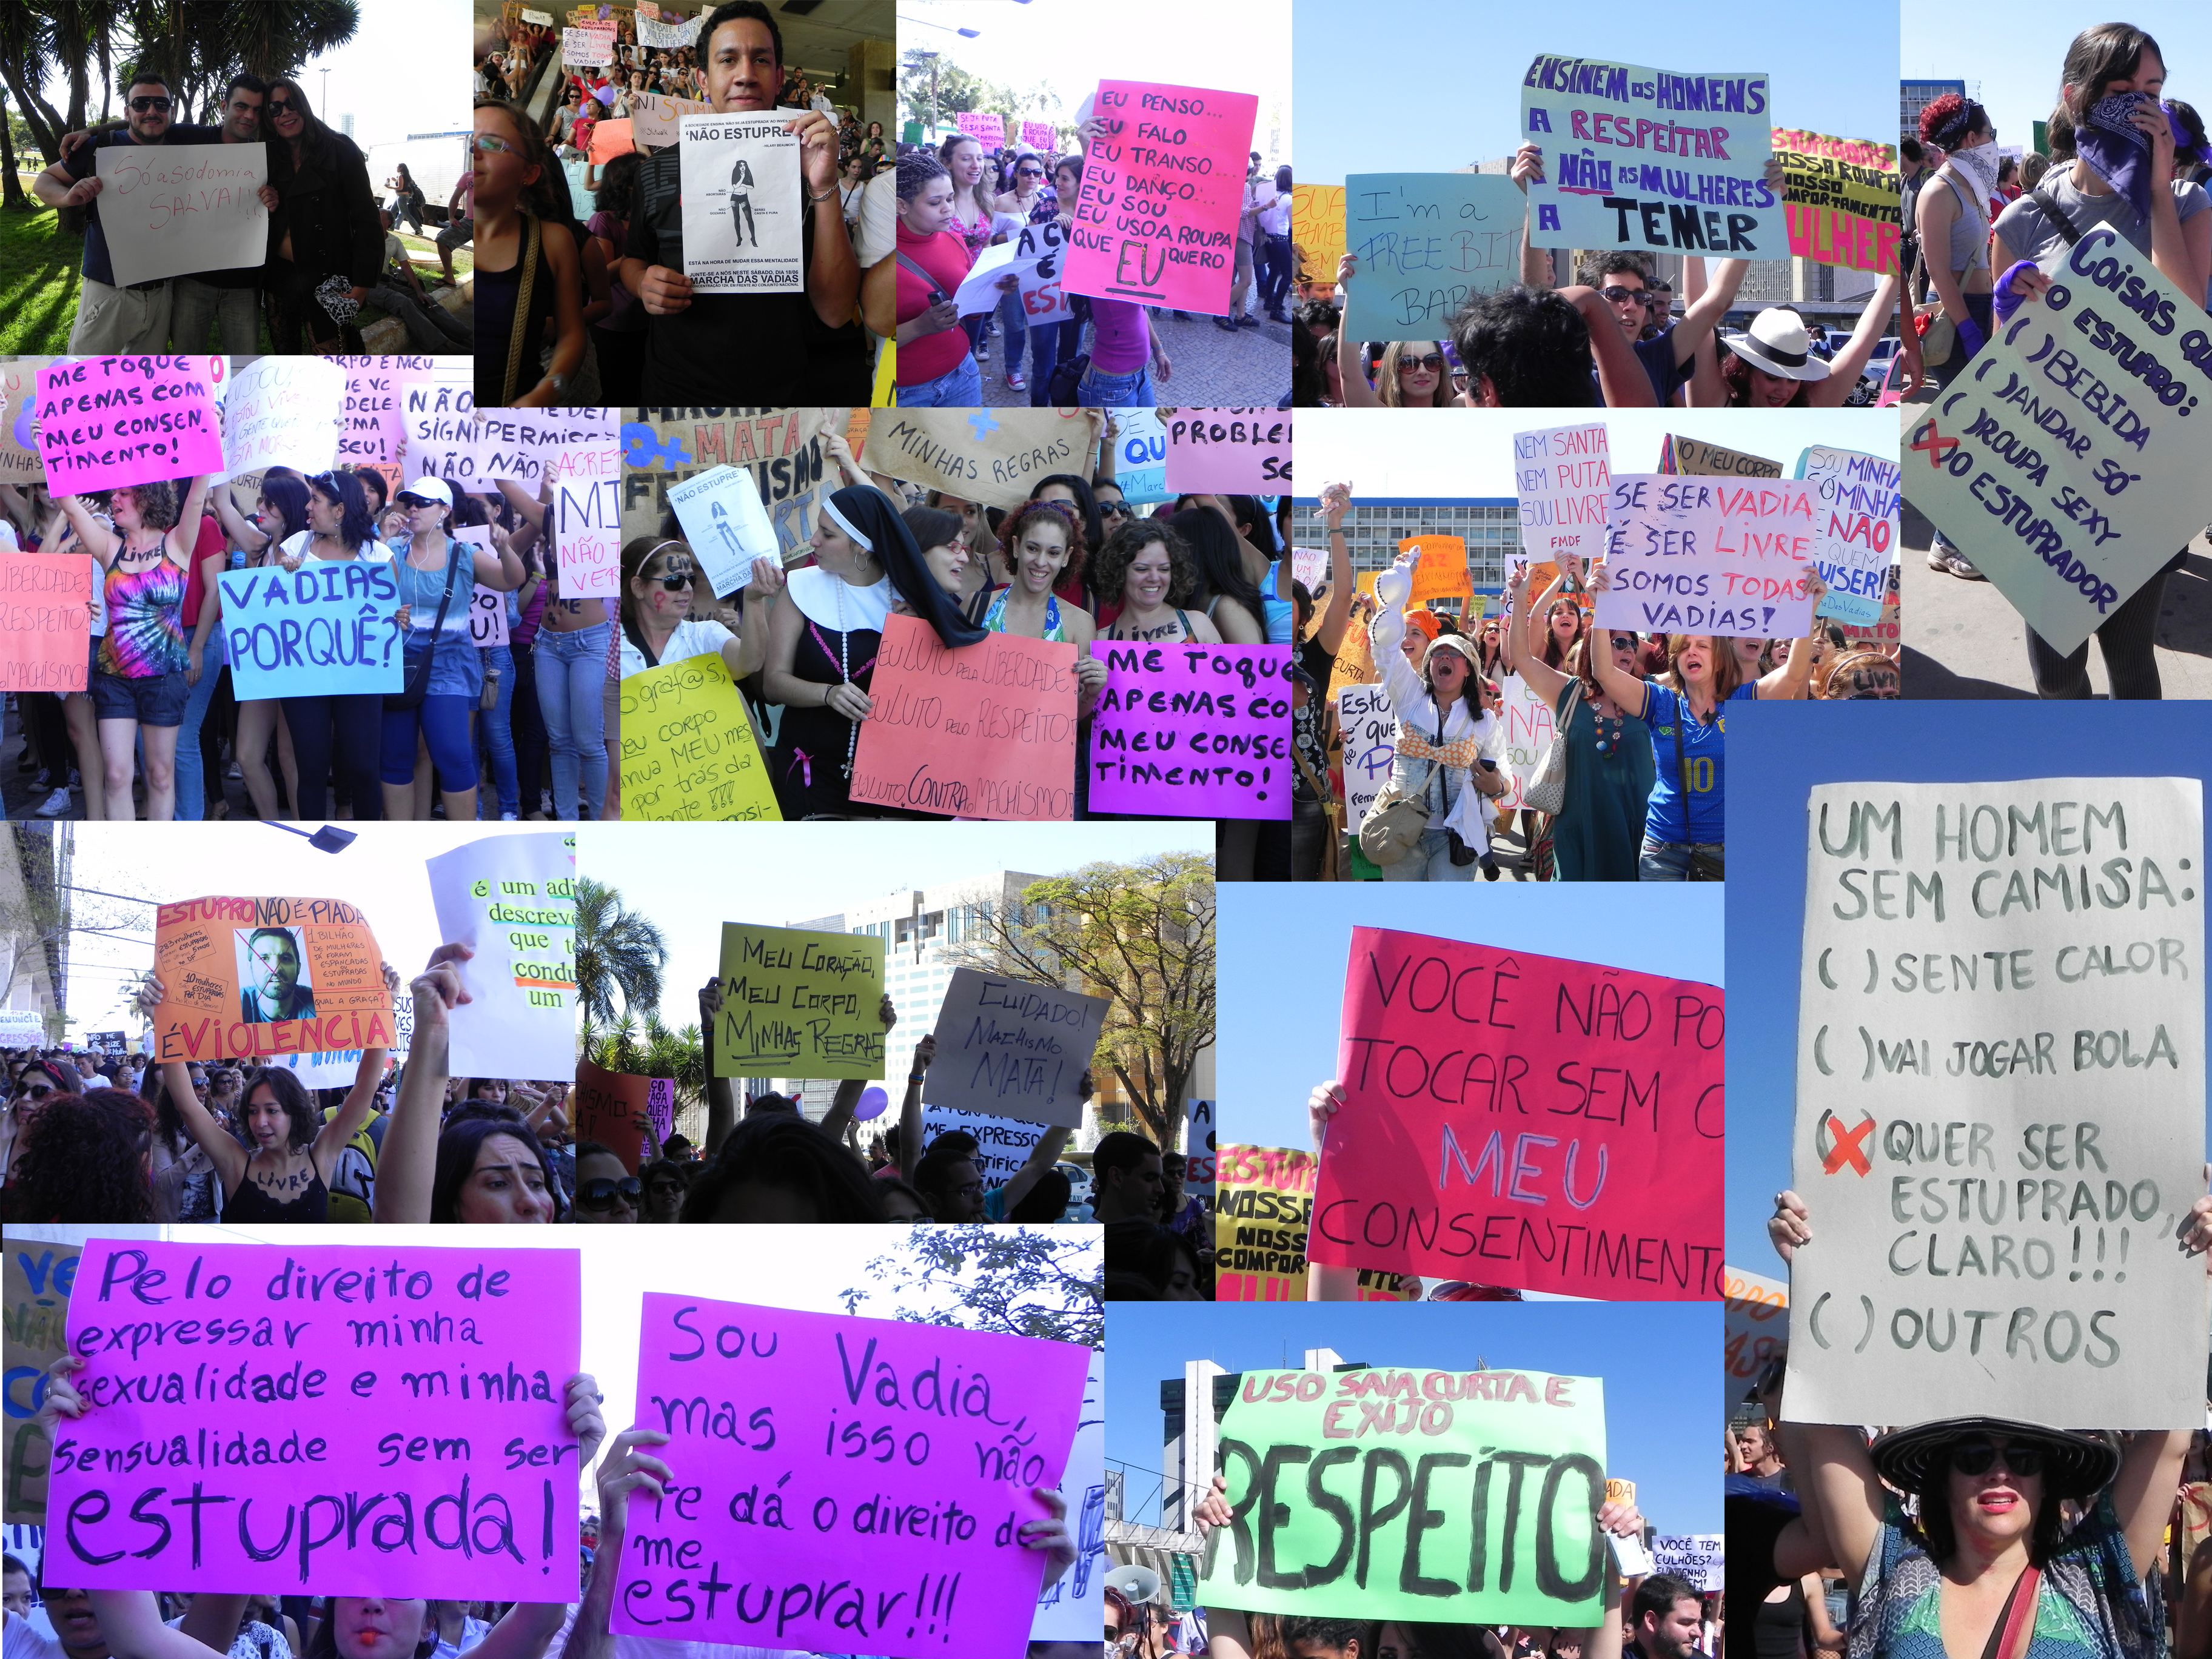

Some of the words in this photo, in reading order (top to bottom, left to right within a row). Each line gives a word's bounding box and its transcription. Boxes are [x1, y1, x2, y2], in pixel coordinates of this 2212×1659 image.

[589, 32, 611, 41] VADIA
[1102, 91, 1128, 108] EU
[1524, 56, 1629, 102] ENSINEM
[1657, 74, 1766, 115] HOMENS
[640, 127, 668, 136] #Slutwalk
[686, 127, 720, 141] 'NÃO
[1091, 142, 1121, 162] EU
[1529, 108, 1552, 132] A
[1570, 109, 1731, 160] RESPEITAR
[1086, 166, 1115, 184] EU
[1558, 149, 1613, 190] NÃO
[1640, 164, 1774, 208] MULHERES
[1077, 204, 1107, 224] EU
[1179, 226, 1232, 250] ROUPA
[1603, 196, 1758, 252] TEMER
[1073, 229, 1113, 253] QUE
[1169, 247, 1225, 269] QUERO
[1117, 240, 1166, 286] EU
[1358, 232, 1443, 275] FREE
[691, 276, 734, 284] MARCHA
[2070, 228, 2177, 337] COISAS
[49, 366, 87, 390] ME
[43, 390, 143, 419] APENAS
[152, 380, 205, 401] COM
[46, 424, 103, 449] MEU
[48, 437, 179, 474] TIMENTO!
[695, 415, 801, 464] MATA
[888, 420, 979, 480] MINHAS
[993, 438, 1071, 484] REGRAS
[1515, 435, 1547, 460] NEM
[1553, 428, 1607, 456] SANTA
[1558, 460, 1611, 489] PUTA
[1810, 448, 1843, 472] SOU
[1521, 503, 1553, 528] SOU
[1664, 483, 1711, 511] SER
[1717, 484, 1812, 521] VADIA
[2051, 485, 2122, 546] SEXY
[1550, 535, 1581, 548] FMDF
[1715, 526, 1808, 560] LIVRE
[1828, 511, 1890, 553] NÃO
[1969, 472, 2119, 614] ESTUPRADOR
[1828, 543, 1879, 572] QUEM
[221, 560, 397, 611] VADIAS
[1612, 568, 1709, 596] SOMOS
[1721, 572, 1808, 603] TODAS
[230, 600, 399, 672] PORQUÊ?
[1643, 600, 1777, 633] VADIAS!
[956, 664, 979, 682] PELA
[1108, 648, 1164, 673] ME
[1102, 689, 1237, 718] APENAS
[945, 719, 970, 736] PELO
[1095, 756, 1270, 800] TIMENTO!
[1934, 800, 2128, 865] HOMEM
[502, 881, 535, 896] um
[1832, 867, 1945, 923] SEM
[1971, 857, 2196, 920] CAMISA:
[156, 898, 255, 928] ESTUPRO
[255, 897, 290, 926] NÃO
[308, 900, 369, 928] PIADA
[318, 926, 354, 940] BILHÃO
[325, 951, 352, 959] FORAM
[326, 942, 366, 951] MULHERES
[509, 931, 549, 952] que
[320, 958, 369, 968] ESPANCADAS
[323, 968, 367, 978] ESTUPRADAS
[1892, 947, 2037, 994] SENTE
[2055, 936, 2189, 983] CALOR
[978, 980, 1088, 1030] CUIDADO!
[1369, 951, 1521, 1030] VOCÊ
[1556, 971, 1652, 1041] NÃO
[725, 1010, 802, 1057] MINHAS
[807, 1017, 886, 1059] REGRAS
[1945, 1030, 2057, 1079] JOGAR
[2072, 1024, 2180, 1073] BOLA
[970, 1050, 1065, 1105] MATA!
[1346, 1037, 1529, 1114] TOCAR
[1547, 1061, 1661, 1133] SEM
[1439, 1122, 1608, 1210] MEU
[1883, 1119, 1996, 1168] QUER
[2017, 1120, 2108, 1173] SER
[1891, 1177, 2177, 1241] ESTUPRADO,
[1888, 1226, 2131, 1283] CLARO!!!
[98, 1248, 232, 1307] Pelo
[267, 1256, 433, 1304] direito
[457, 1263, 512, 1303] de
[75, 1316, 311, 1361] expressar
[347, 1311, 484, 1347] minha
[668, 1306, 778, 1362] Sou
[1890, 1305, 2121, 1369] OUTROS
[1241, 1373, 1326, 1404] USO
[1335, 1368, 1419, 1399] SAIA
[1421, 1370, 1543, 1404] CURTA
[1322, 1398, 1455, 1440] EXIJO
[53, 1427, 328, 1476] sensualidade
[378, 1432, 471, 1465] sem
[504, 1435, 580, 1470] ser
[651, 1395, 777, 1452] mas
[825, 1408, 930, 1466] isso
[974, 1430, 1045, 1489] não
[65, 1472, 555, 1586] estuprada!
[729, 1470, 795, 1531] dá
[853, 1493, 977, 1546] direito
[1199, 1436, 1608, 1604] RESPEITO
[1655, 1553, 1712, 1565] CULHÕES?
[1660, 1538, 1692, 1550] VOCÊ
[1698, 1541, 1721, 1551] TEM
[623, 1561, 962, 1644] estuprar!!!
